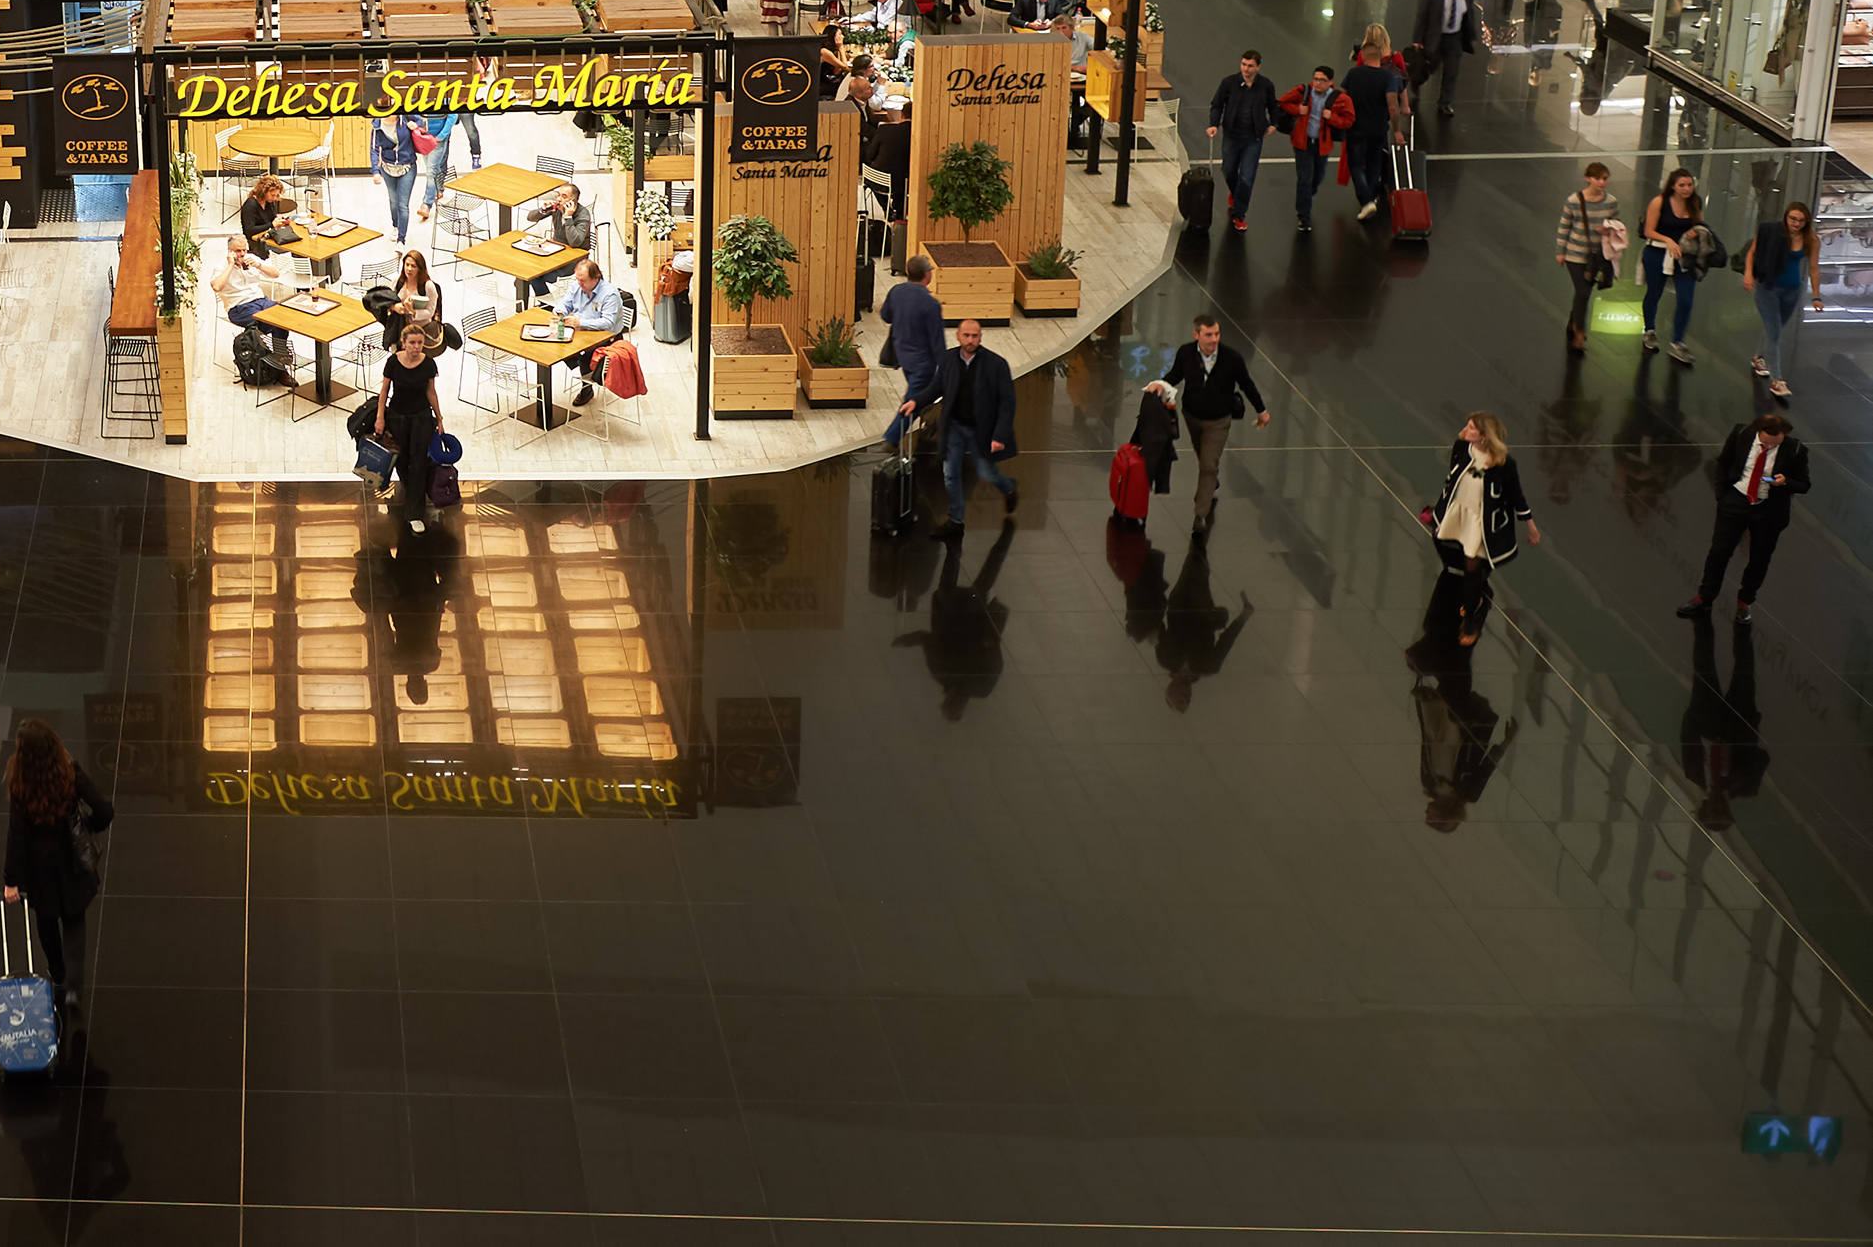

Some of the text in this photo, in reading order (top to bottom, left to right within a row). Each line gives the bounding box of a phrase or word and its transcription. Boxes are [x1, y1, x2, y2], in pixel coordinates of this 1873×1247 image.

[947, 63, 1047, 91] Dehesa
[178, 56, 697, 118] Dehesa Santa María
[950, 90, 1041, 107] Santa María
[741, 125, 808, 137] COFFEE
[65, 140, 128, 151] COFFEE
[741, 139, 808, 151] &TAPAS
[65, 153, 129, 164] &TAPAS
[732, 163, 829, 181] Santa María
